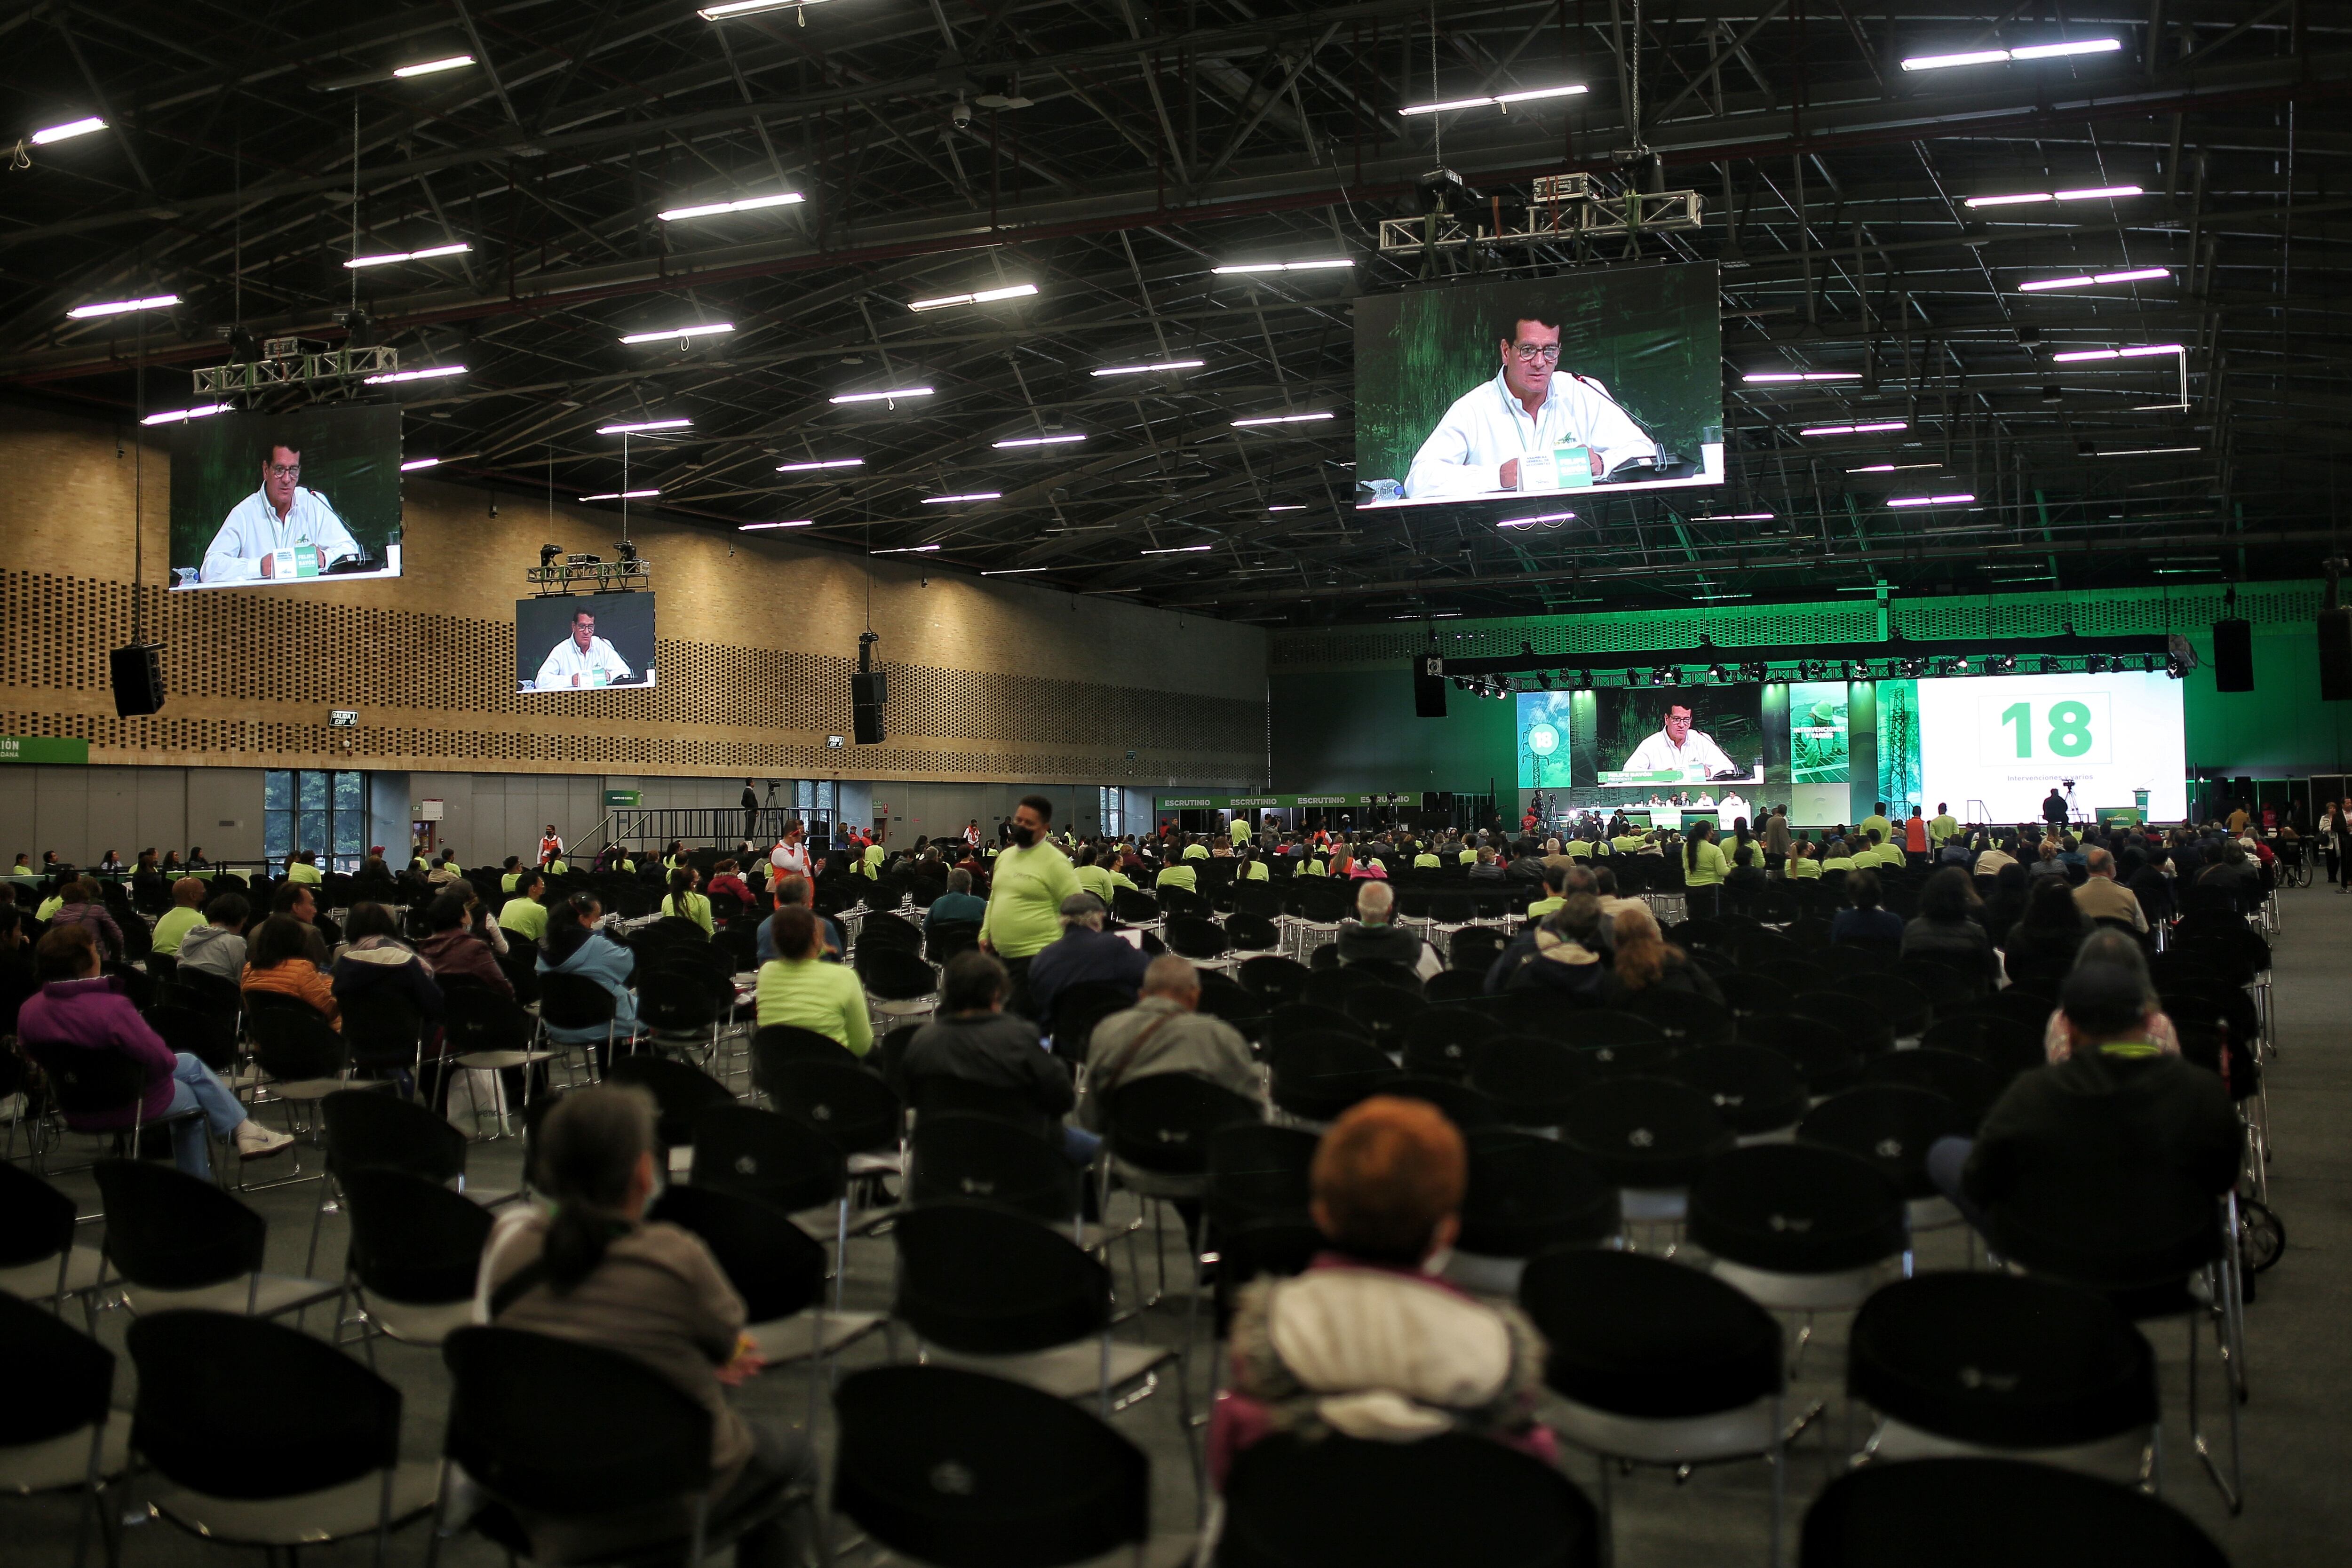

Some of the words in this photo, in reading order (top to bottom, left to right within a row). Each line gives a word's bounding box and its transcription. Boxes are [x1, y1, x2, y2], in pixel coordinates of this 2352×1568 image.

[2002, 700, 2092, 758] 18
[0, 738, 19, 750] IÓN
[1534, 731, 1553, 748] 18
